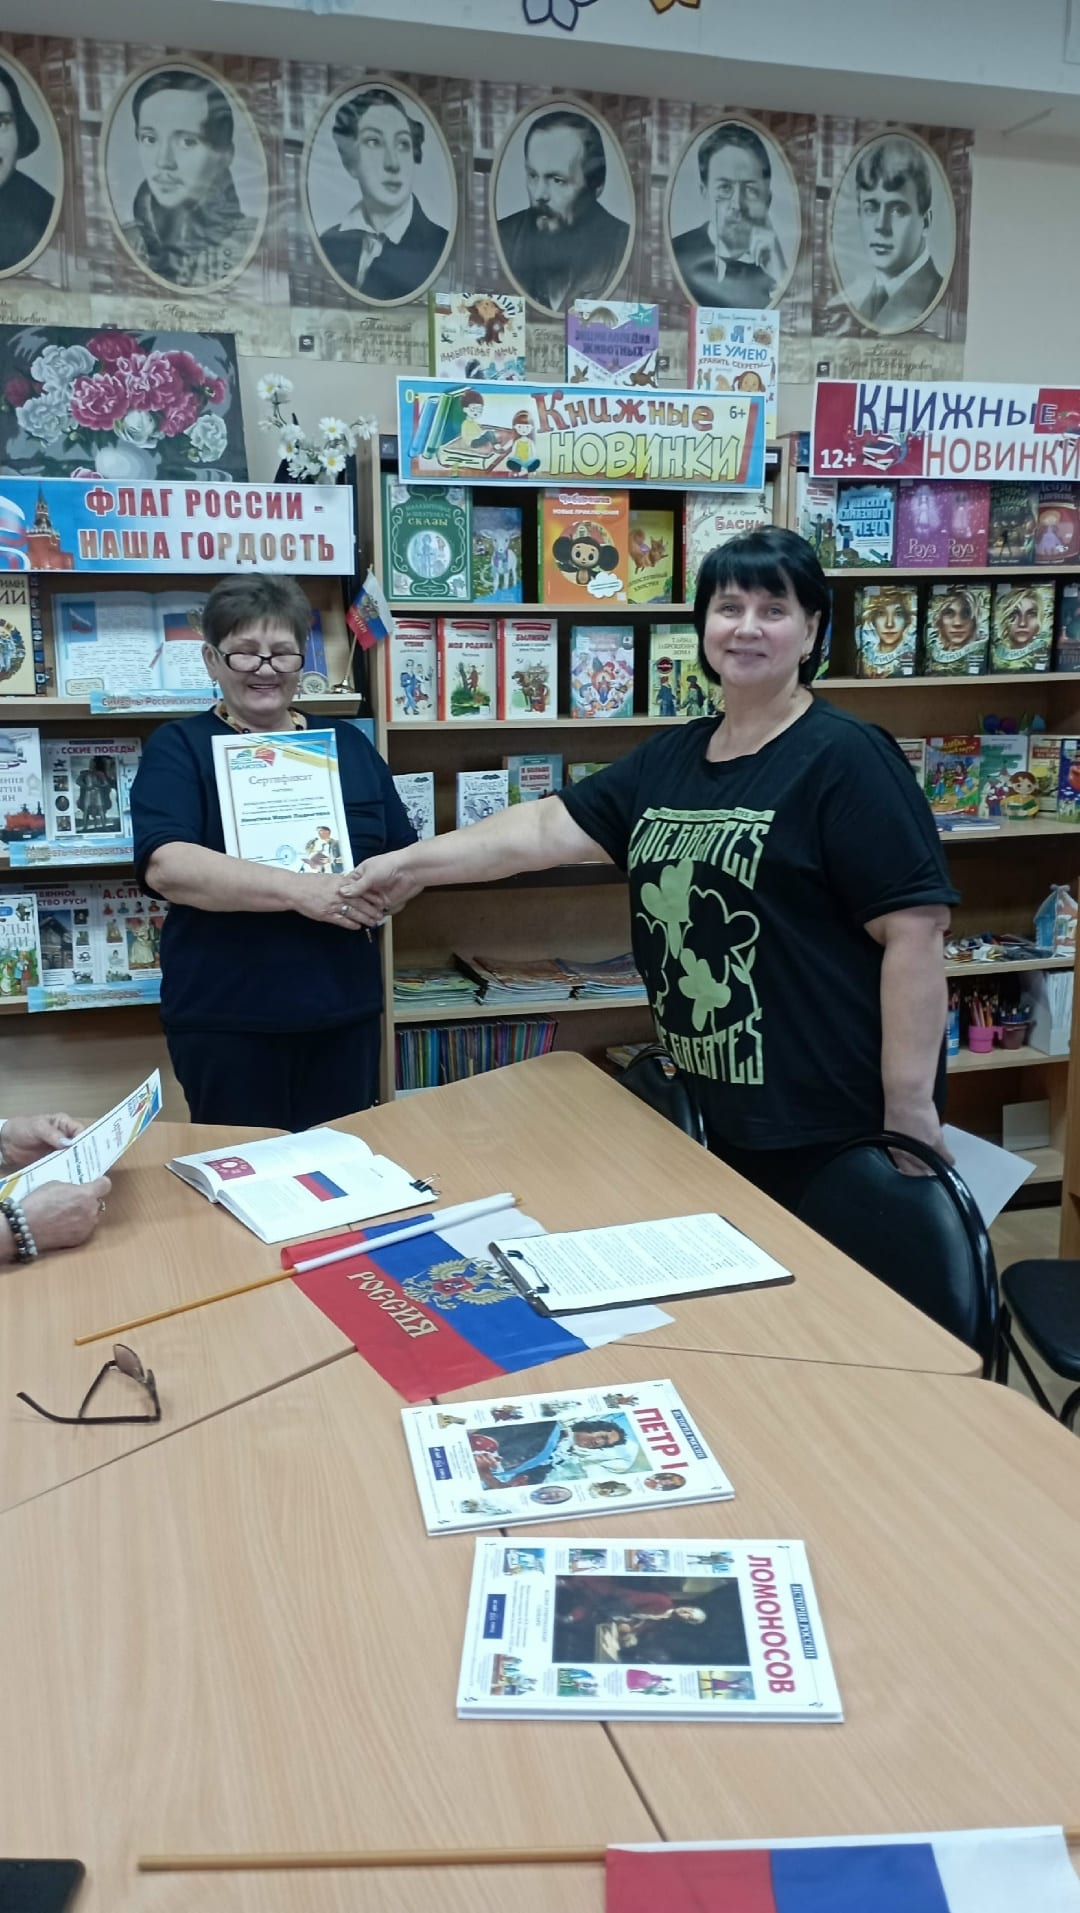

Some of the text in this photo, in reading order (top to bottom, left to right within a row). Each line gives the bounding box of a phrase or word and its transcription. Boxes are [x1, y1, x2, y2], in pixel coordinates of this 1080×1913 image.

[730, 325, 745, 343] Я
[703, 344, 767, 361] НЕ УМЕЮ
[531, 390, 714, 434] Книжные
[729, 405, 746, 420] 6+
[856, 383, 1058, 437] КНИЖНЫЕ
[550, 431, 739, 482] НОВИНКИ
[820, 449, 856, 469] 12+
[925, 433, 1080, 479] НОВИНКИ
[85, 487, 173, 517] ФЛАГ
[185, 488, 303, 520] РОССИИ
[408, 518, 448, 526] СКАЗЫ
[77, 530, 335, 565] НАША ГОРДОСТЬ
[94, 745, 136, 754] ПОБЕДЫ
[63, 897, 87, 905] РУСИ
[347, 1271, 439, 1338] РОССИЯ
[632, 1408, 681, 1457] ПЕТР
[747, 1555, 796, 1693] ЛОМОНОСОВ
[790, 1584, 817, 1659] ИСТОРИЯ РОССИИ
